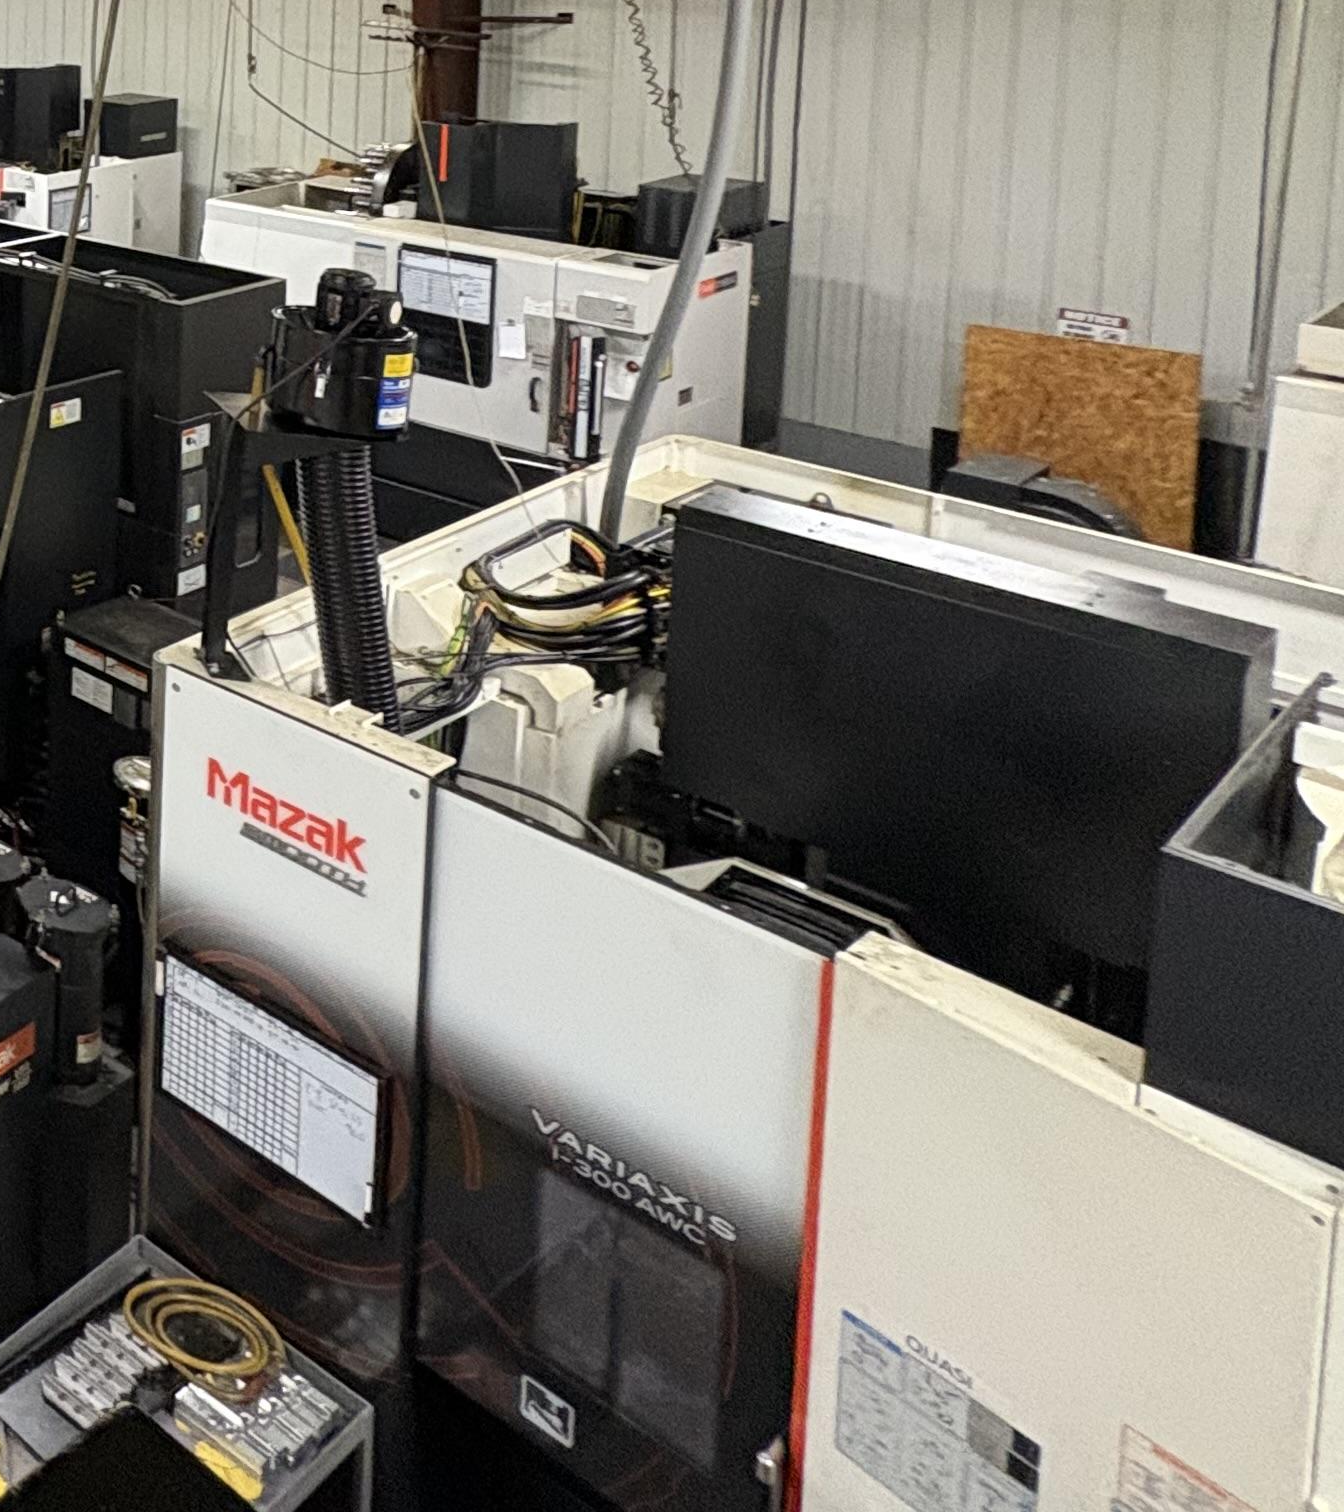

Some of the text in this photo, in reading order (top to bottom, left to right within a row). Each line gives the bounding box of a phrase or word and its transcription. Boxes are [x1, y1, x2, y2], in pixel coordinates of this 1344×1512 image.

[206, 756, 369, 875] Mazak
[530, 1108, 737, 1242] VARIAXIS
[635, 1197, 706, 1245] AWC
